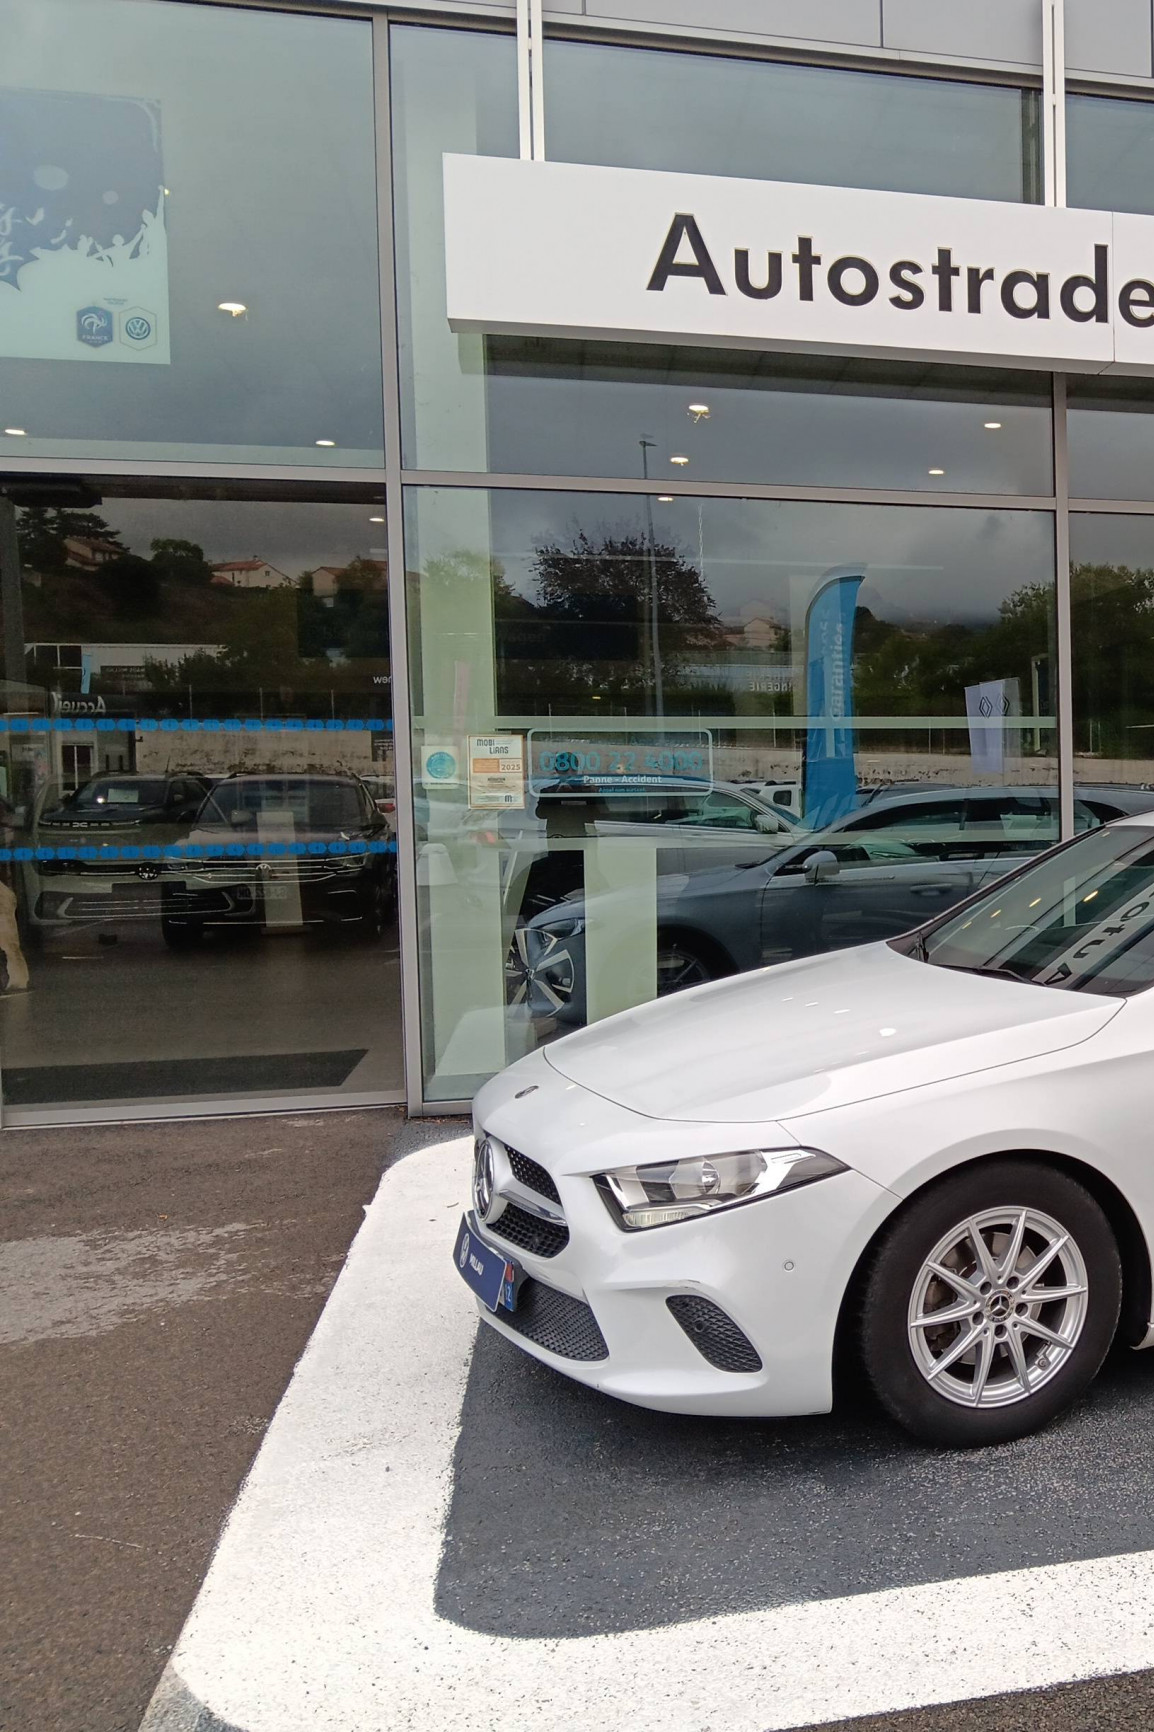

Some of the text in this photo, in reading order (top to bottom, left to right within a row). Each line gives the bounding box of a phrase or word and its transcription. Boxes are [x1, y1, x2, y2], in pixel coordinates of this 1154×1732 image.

[477, 739, 495, 747] MOBI
[541, 752, 601, 772] 0800
[609, 752, 637, 771] 22
[584, 776, 613, 784] Panne
[622, 775, 663, 784] Accident
